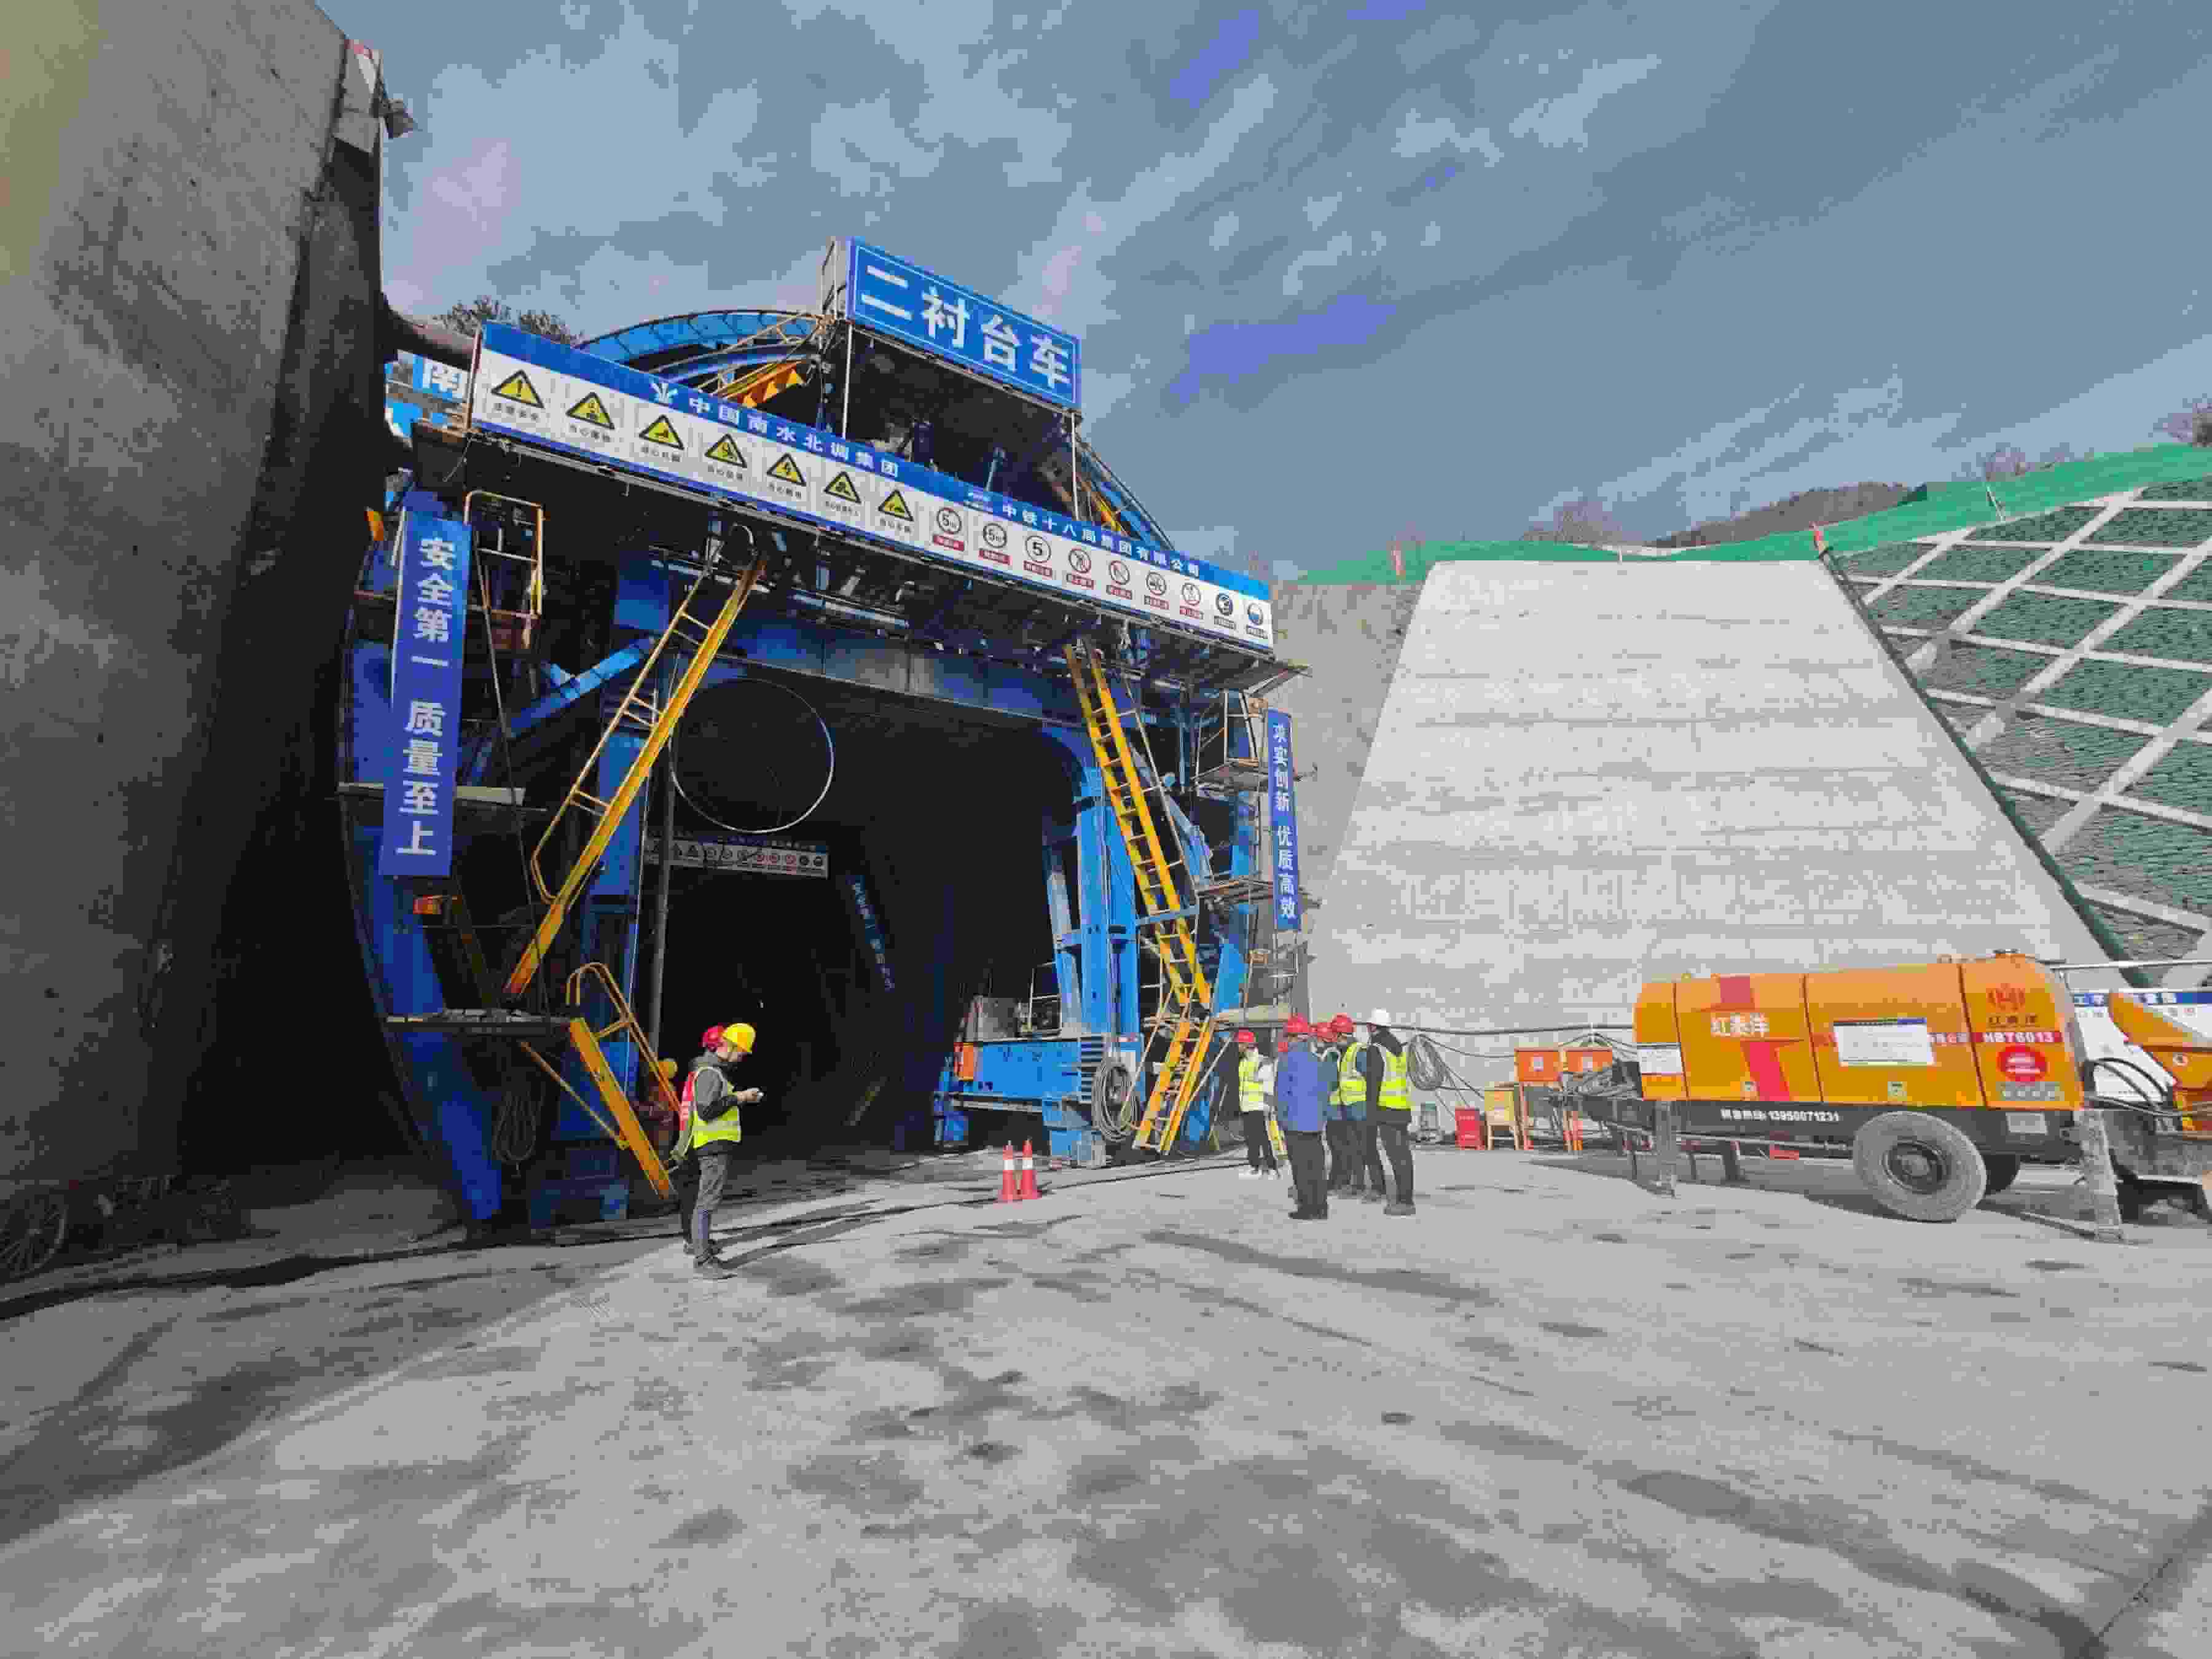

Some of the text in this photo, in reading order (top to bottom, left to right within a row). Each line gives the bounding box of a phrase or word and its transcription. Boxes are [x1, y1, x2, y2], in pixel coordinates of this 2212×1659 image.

[860, 264, 1071, 389] 二衬台车
[688, 396, 898, 478] 中国南水北调集团
[1002, 504, 1200, 578] 中铁十八局集团有限公司
[1032, 541, 1044, 556] 5
[395, 536, 456, 856] 安全第一 质量至上
